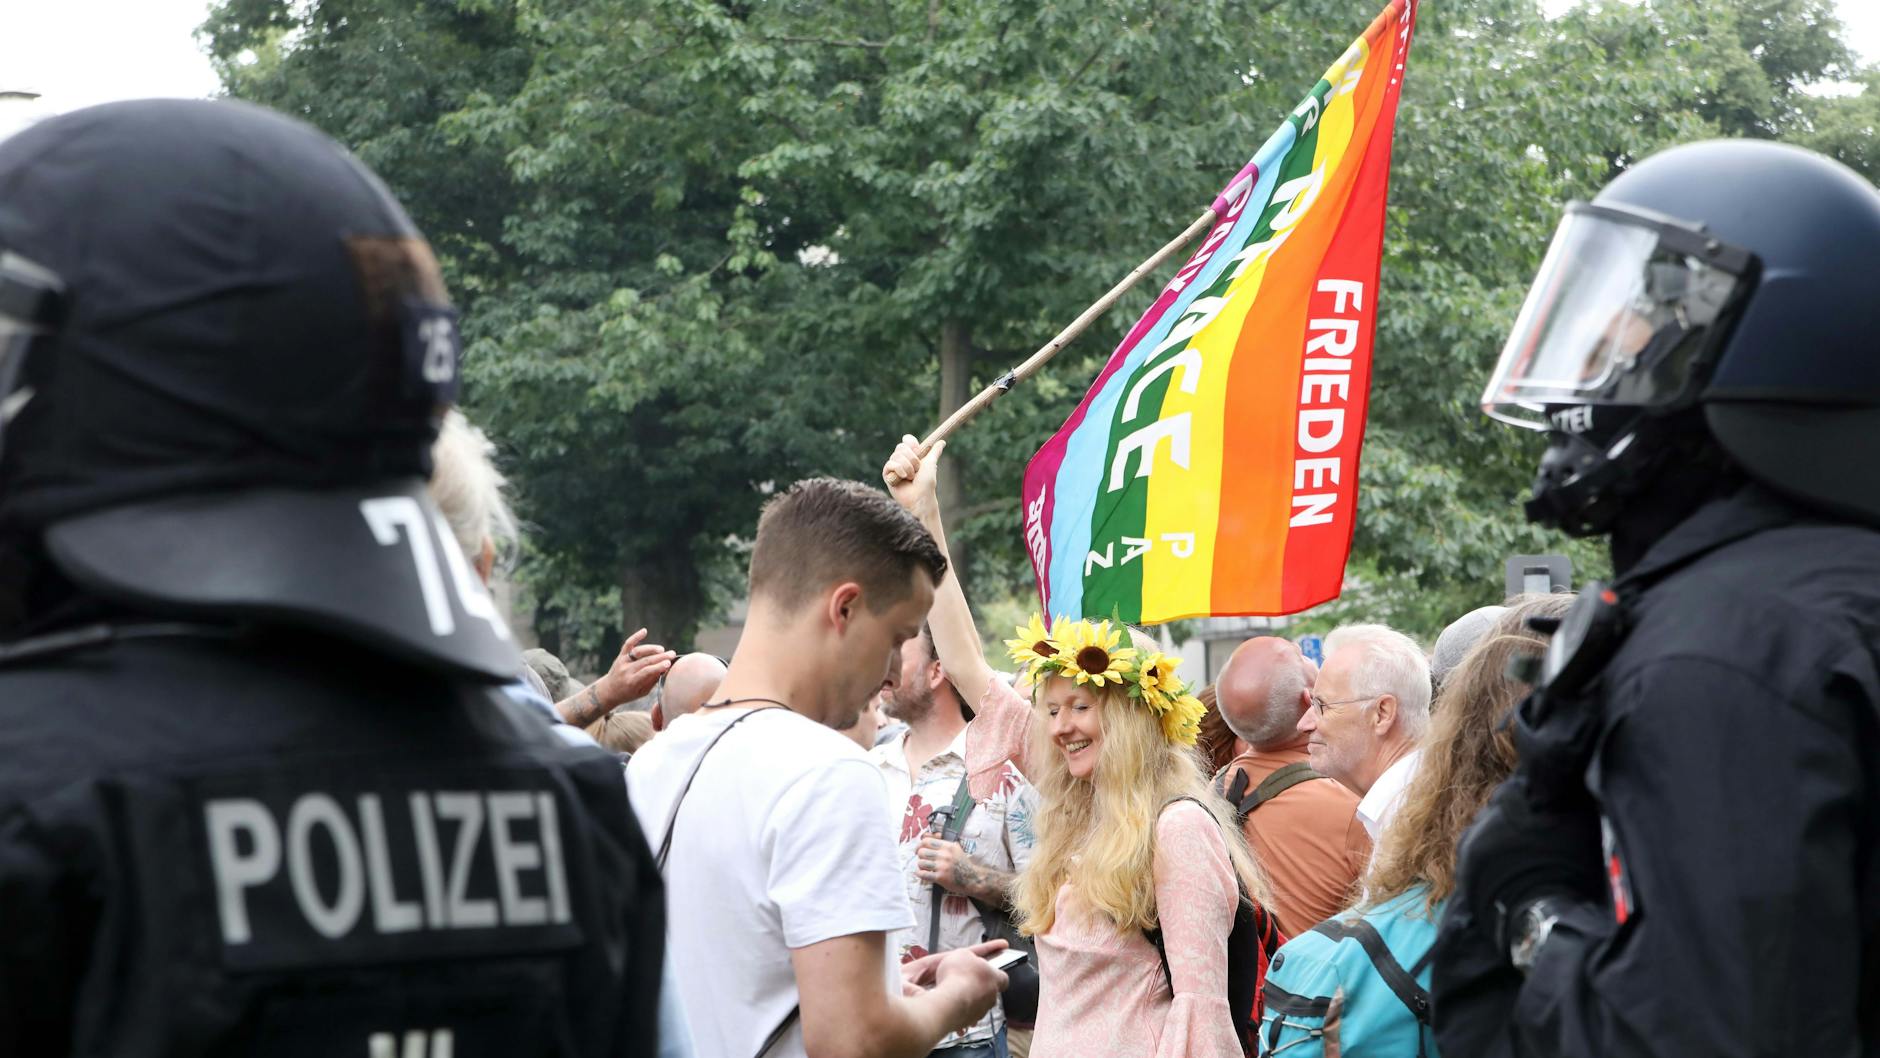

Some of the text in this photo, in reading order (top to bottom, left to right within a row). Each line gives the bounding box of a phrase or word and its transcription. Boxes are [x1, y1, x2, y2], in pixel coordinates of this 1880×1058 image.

[1107, 157, 1327, 493] PEACE
[1289, 278, 1364, 528] FRIEDEN
[1085, 532, 1195, 577] PAZ
[206, 791, 571, 945] POLIZEI
